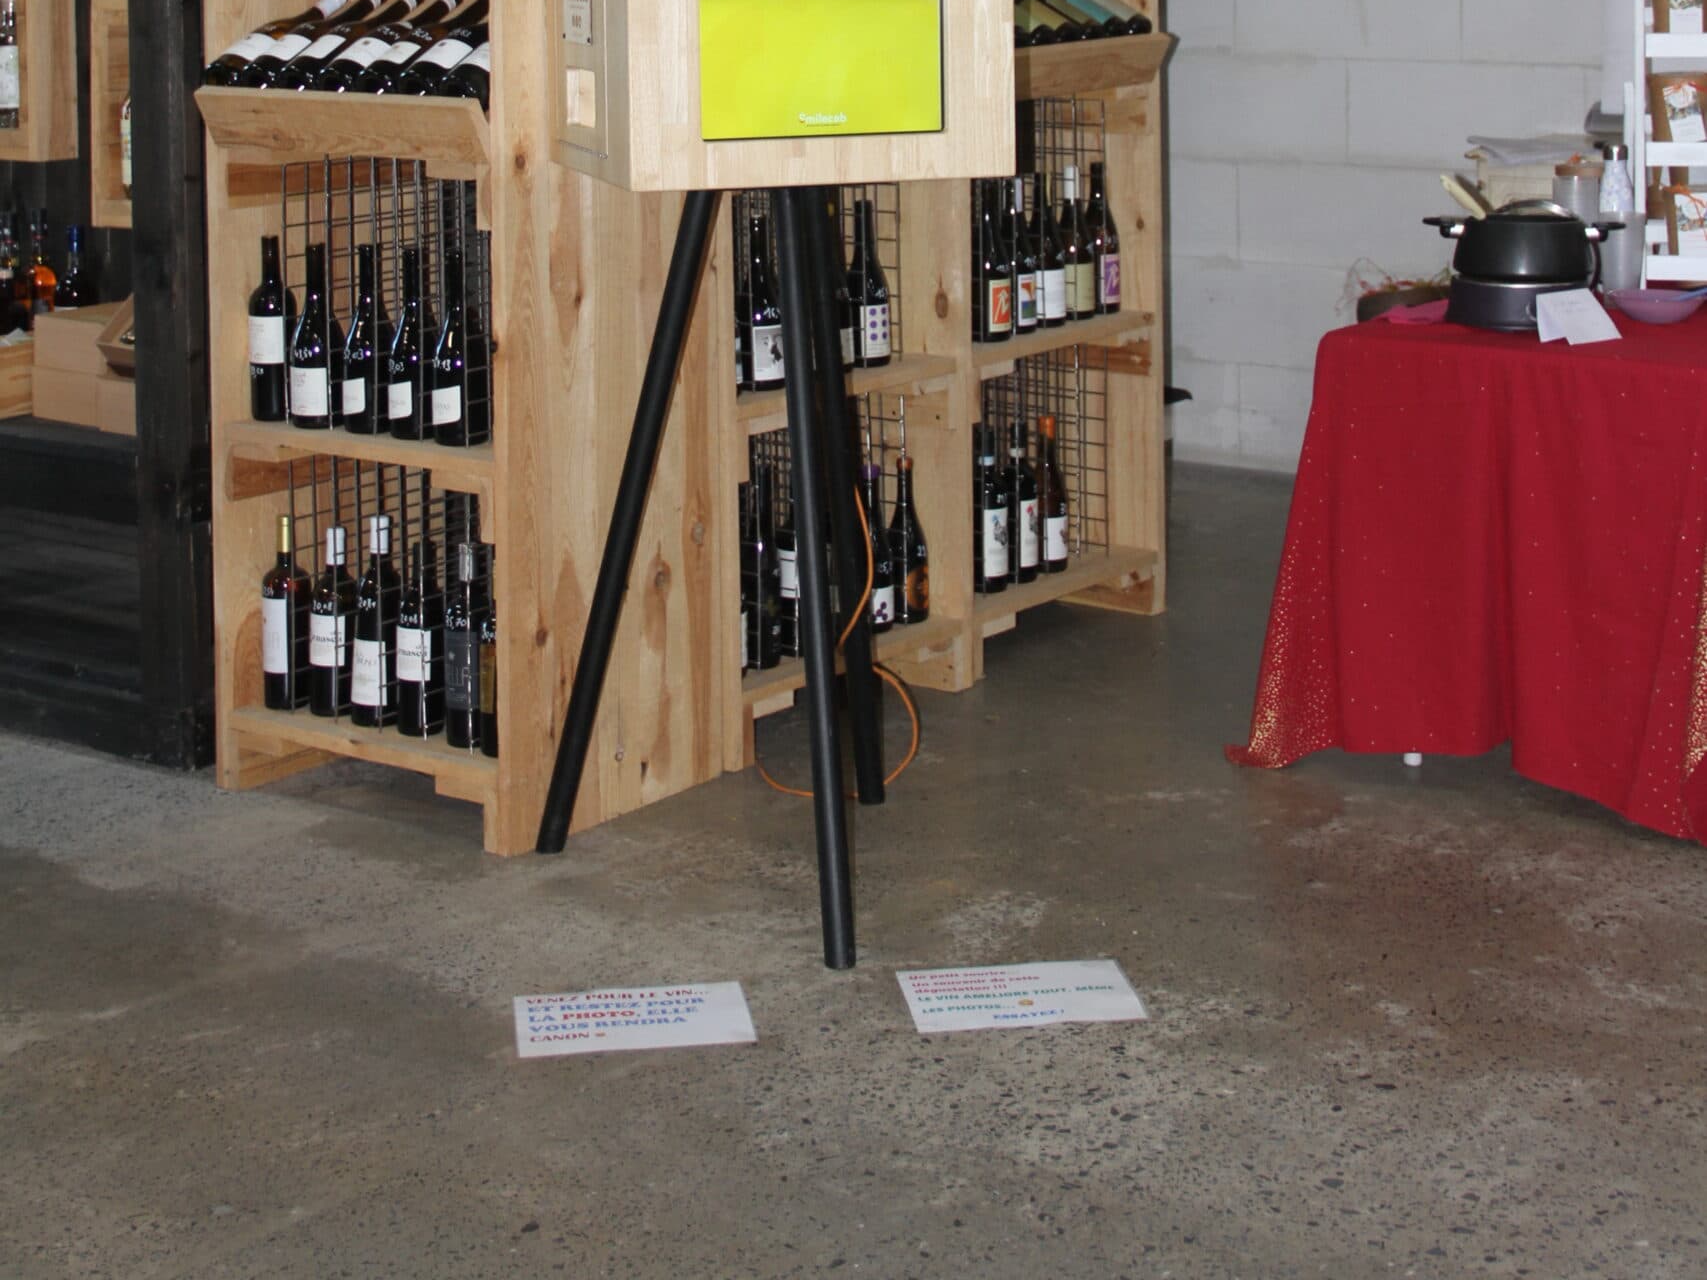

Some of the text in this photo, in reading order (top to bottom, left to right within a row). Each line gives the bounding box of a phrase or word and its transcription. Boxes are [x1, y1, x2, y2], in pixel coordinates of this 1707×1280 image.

[528, 996, 705, 1013] ET RESTEZ POUR
[528, 1013, 556, 1023] LA
[647, 1005, 699, 1016] ELLE
[529, 1016, 688, 1033] VOUS RENDRA
[530, 1031, 590, 1043] CANON
